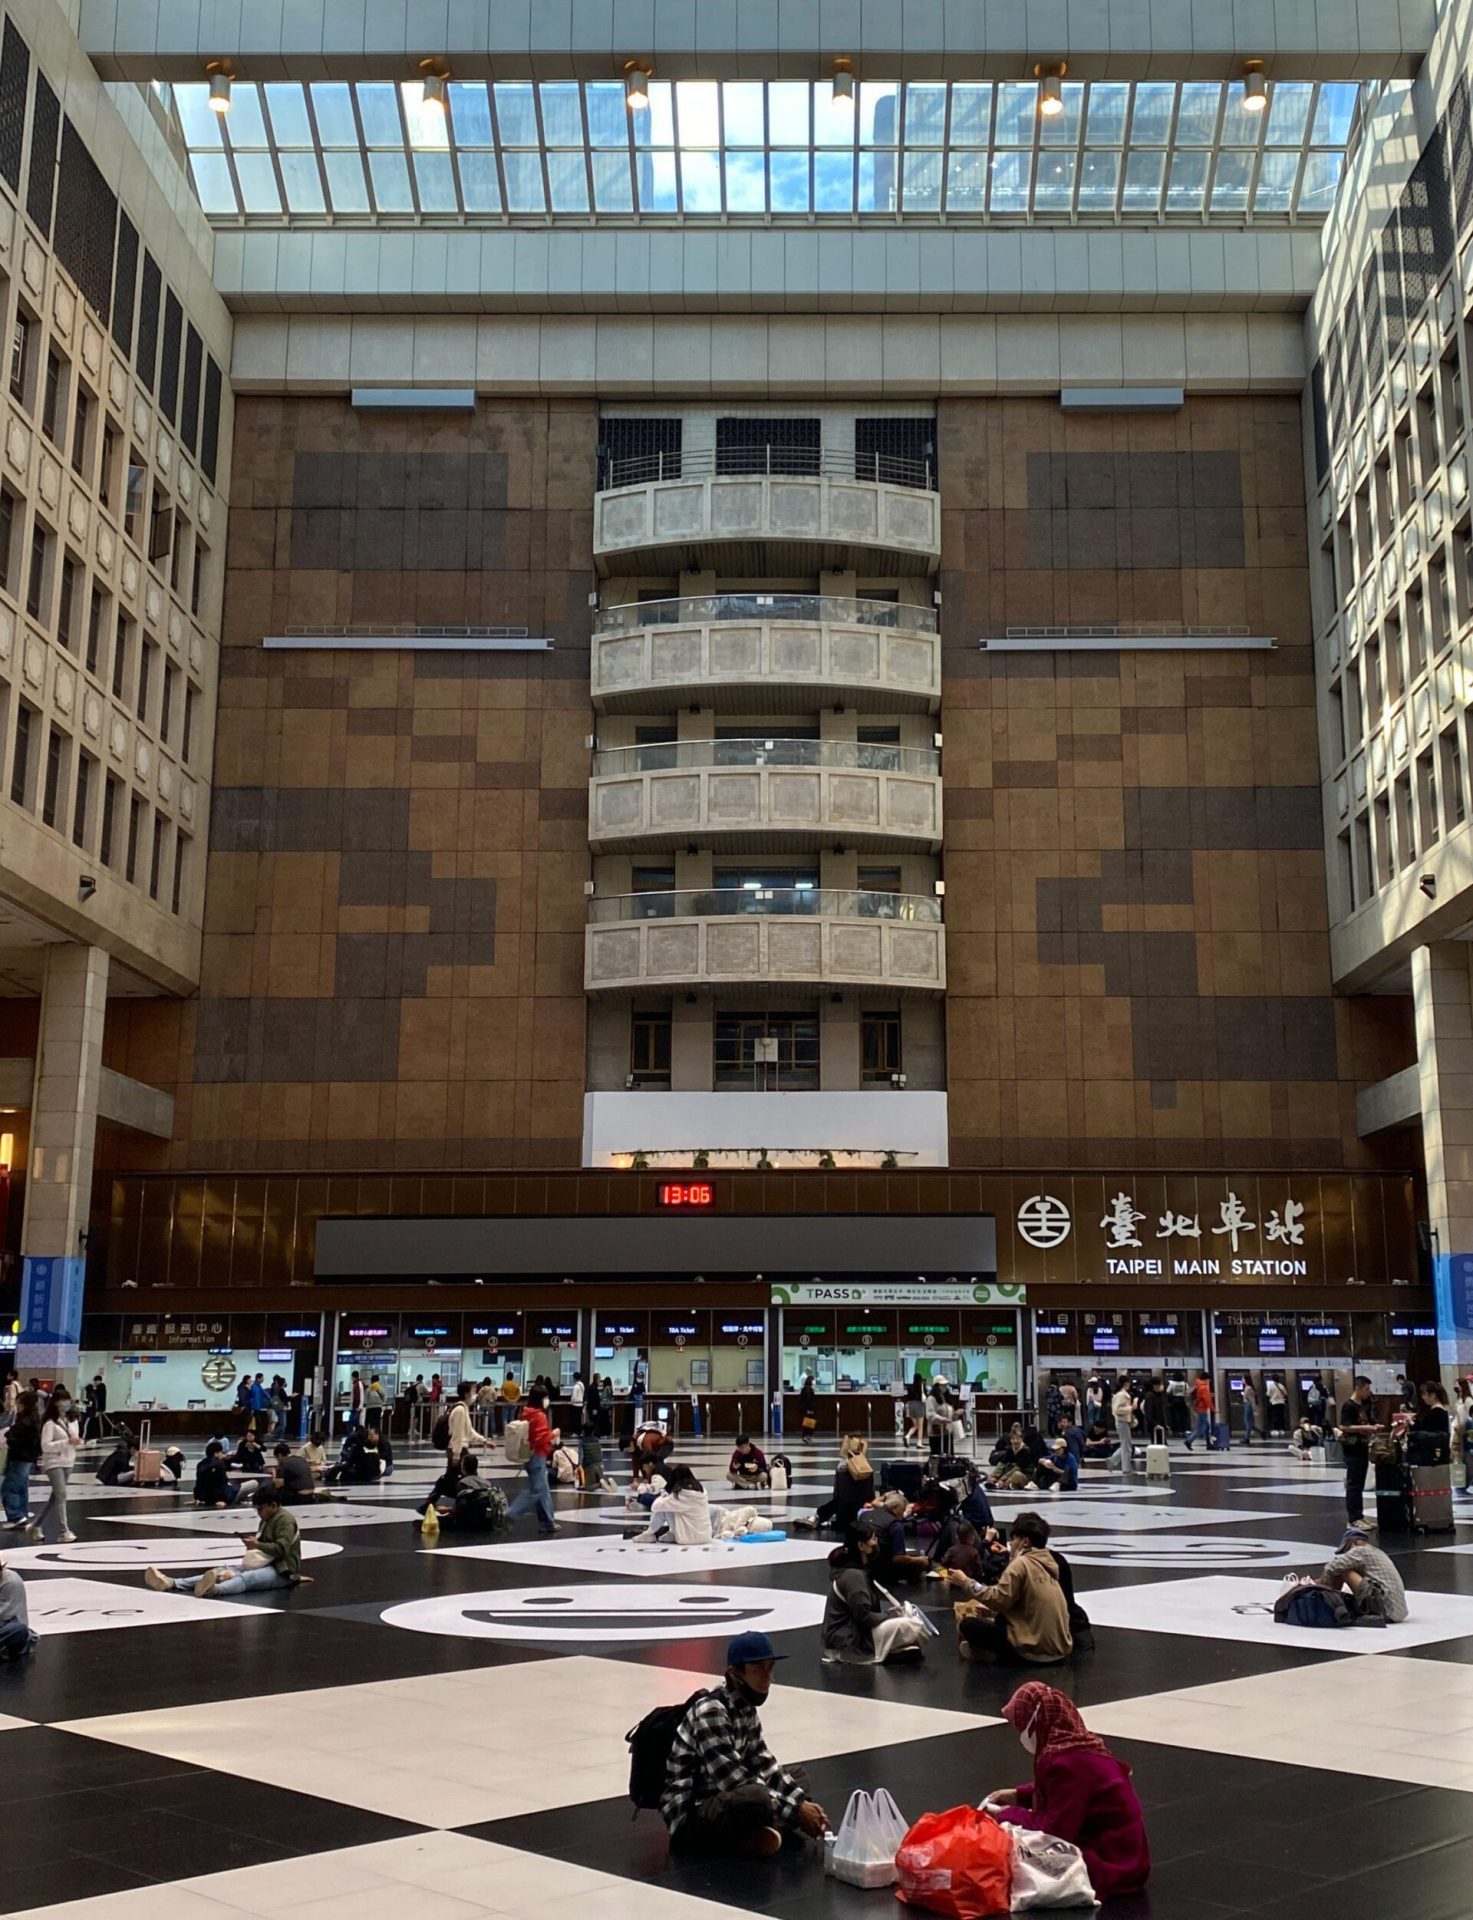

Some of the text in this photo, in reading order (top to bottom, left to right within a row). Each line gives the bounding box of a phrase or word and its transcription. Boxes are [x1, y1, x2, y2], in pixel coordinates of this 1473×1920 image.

[664, 1186, 710, 1204] 13:06
[1099, 1191, 1306, 1253] 臺北車站
[1106, 1259, 1307, 1275] TAIPEI MAIN STATION
[806, 1288, 850, 1299] TPASS
[1228, 1316, 1333, 1327] Tickets Vending Machine
[168, 1335, 215, 1344] Information
